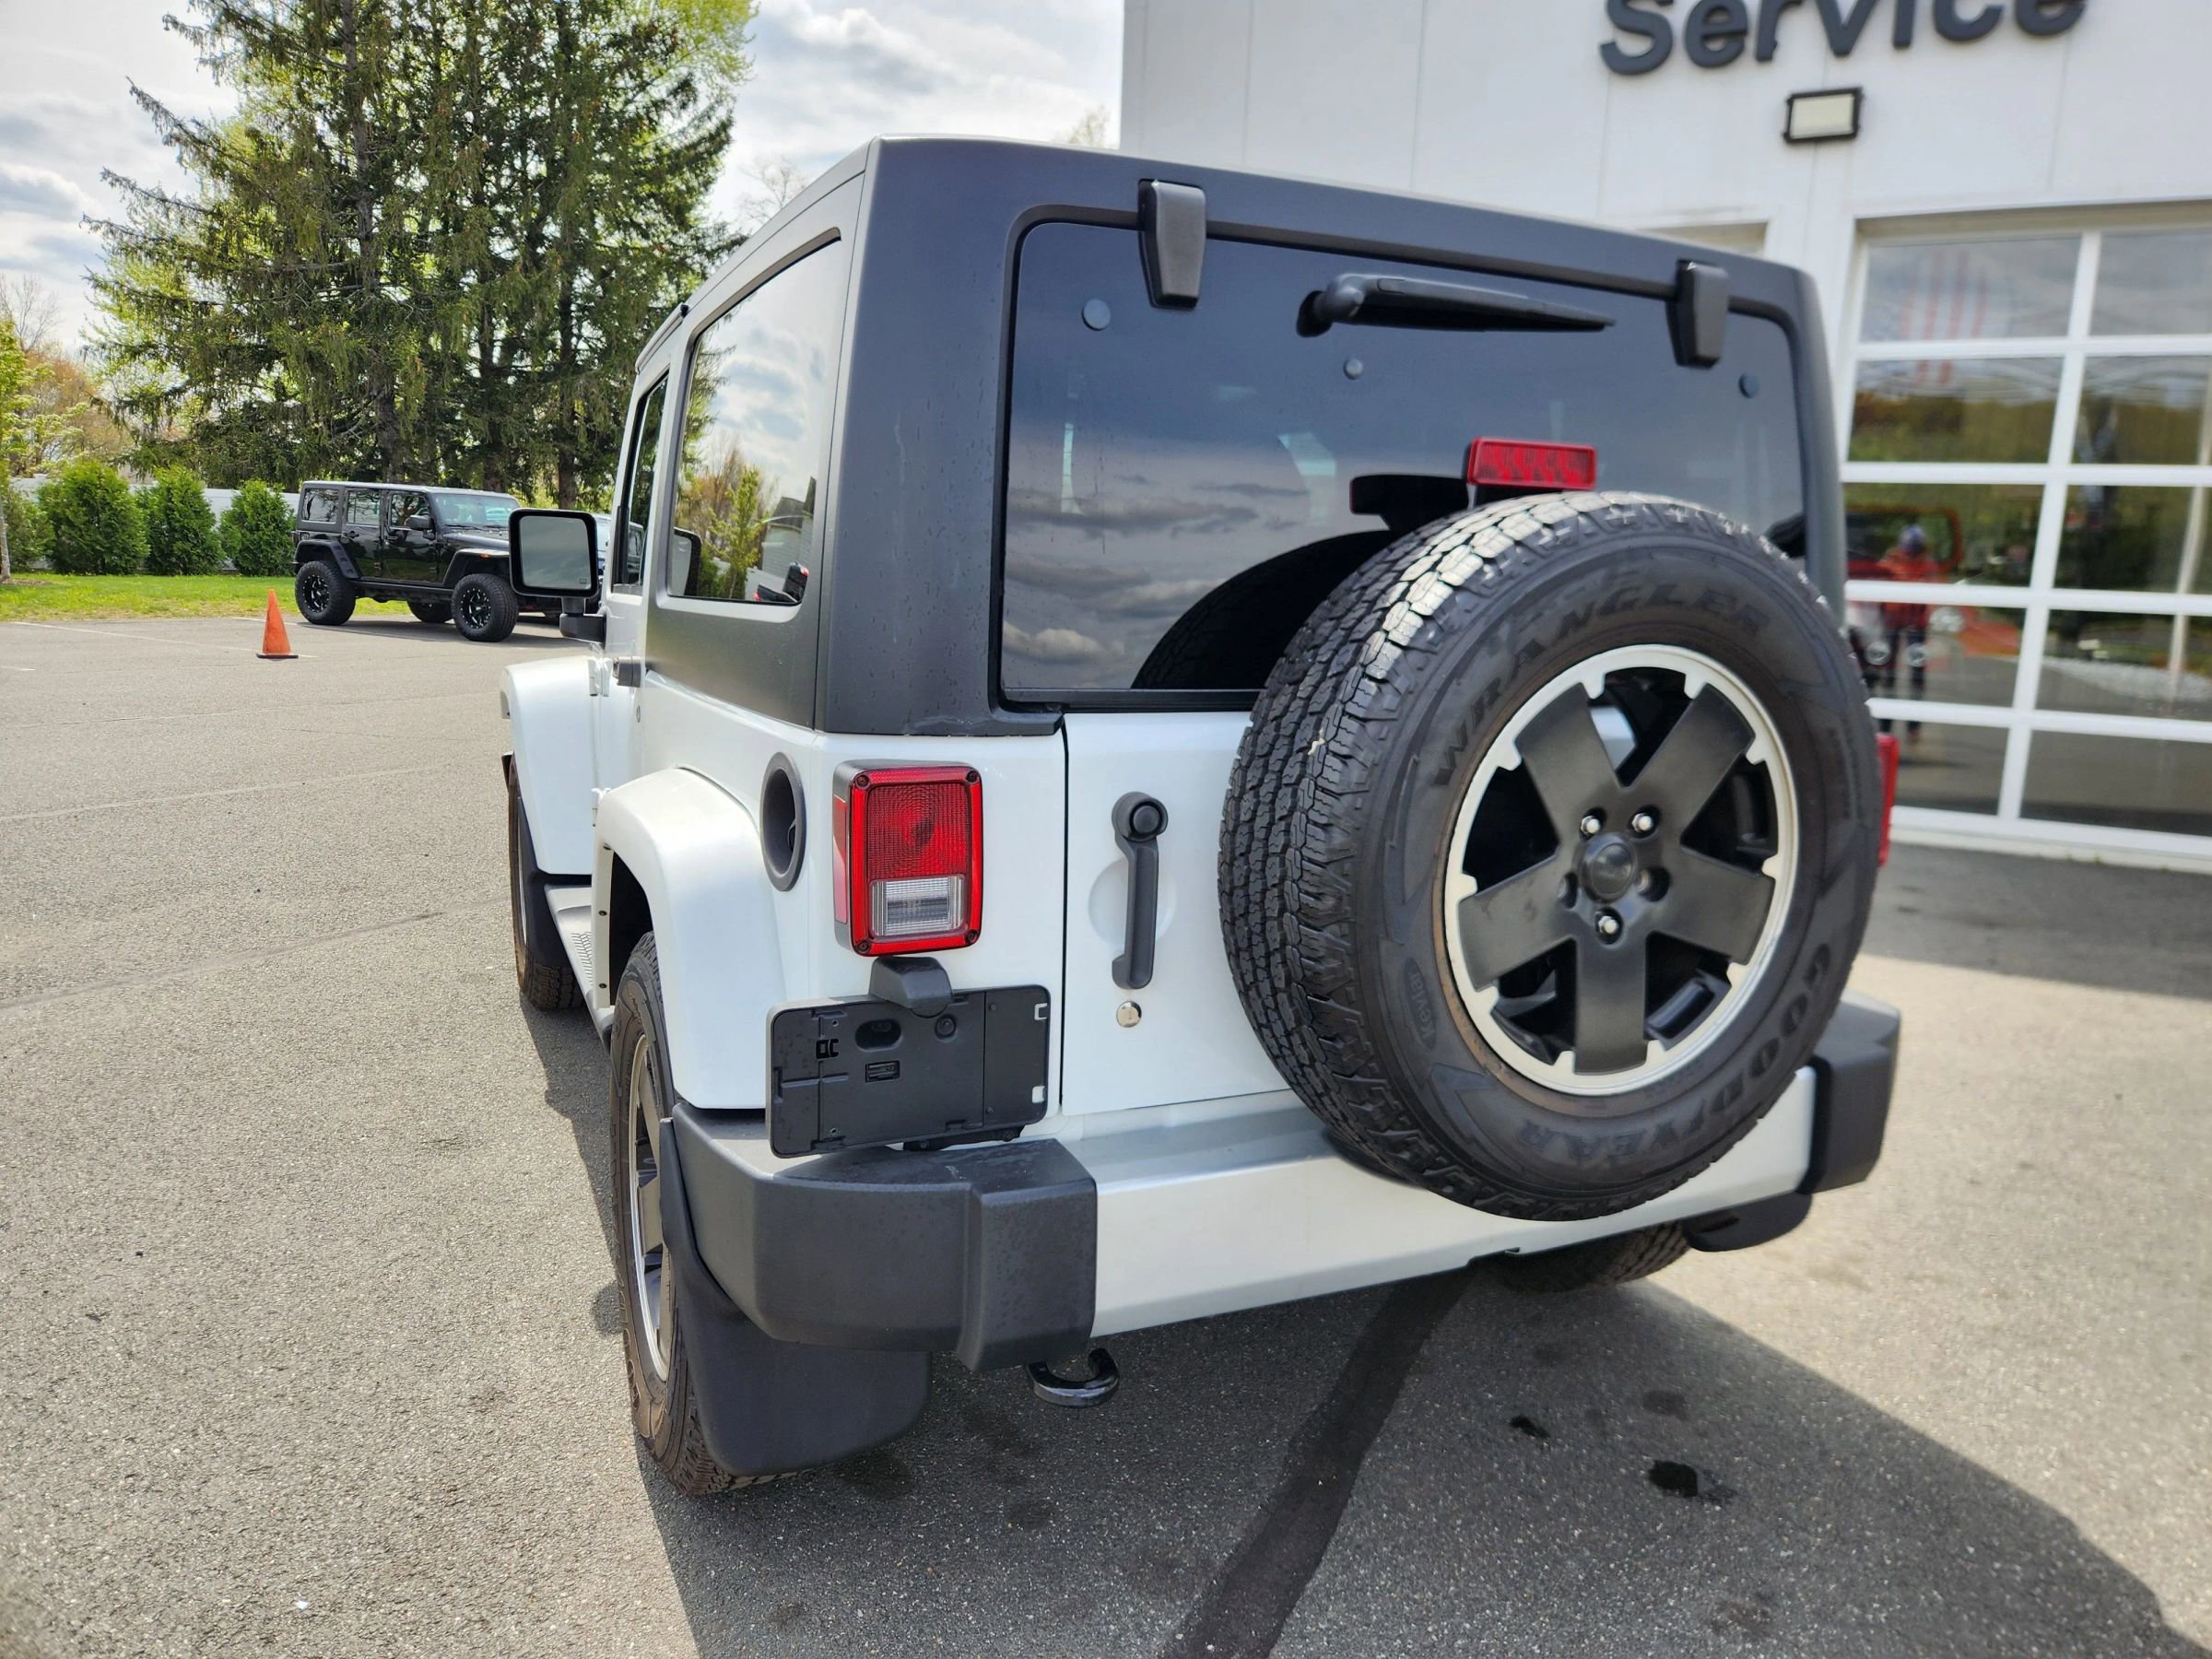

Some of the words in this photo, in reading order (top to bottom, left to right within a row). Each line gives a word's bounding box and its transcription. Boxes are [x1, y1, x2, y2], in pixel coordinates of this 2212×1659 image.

[1600, 0, 2086, 76] Service
[1431, 582, 1771, 787] WRANGLER
[1515, 943, 1831, 1160] GOODYEAR
